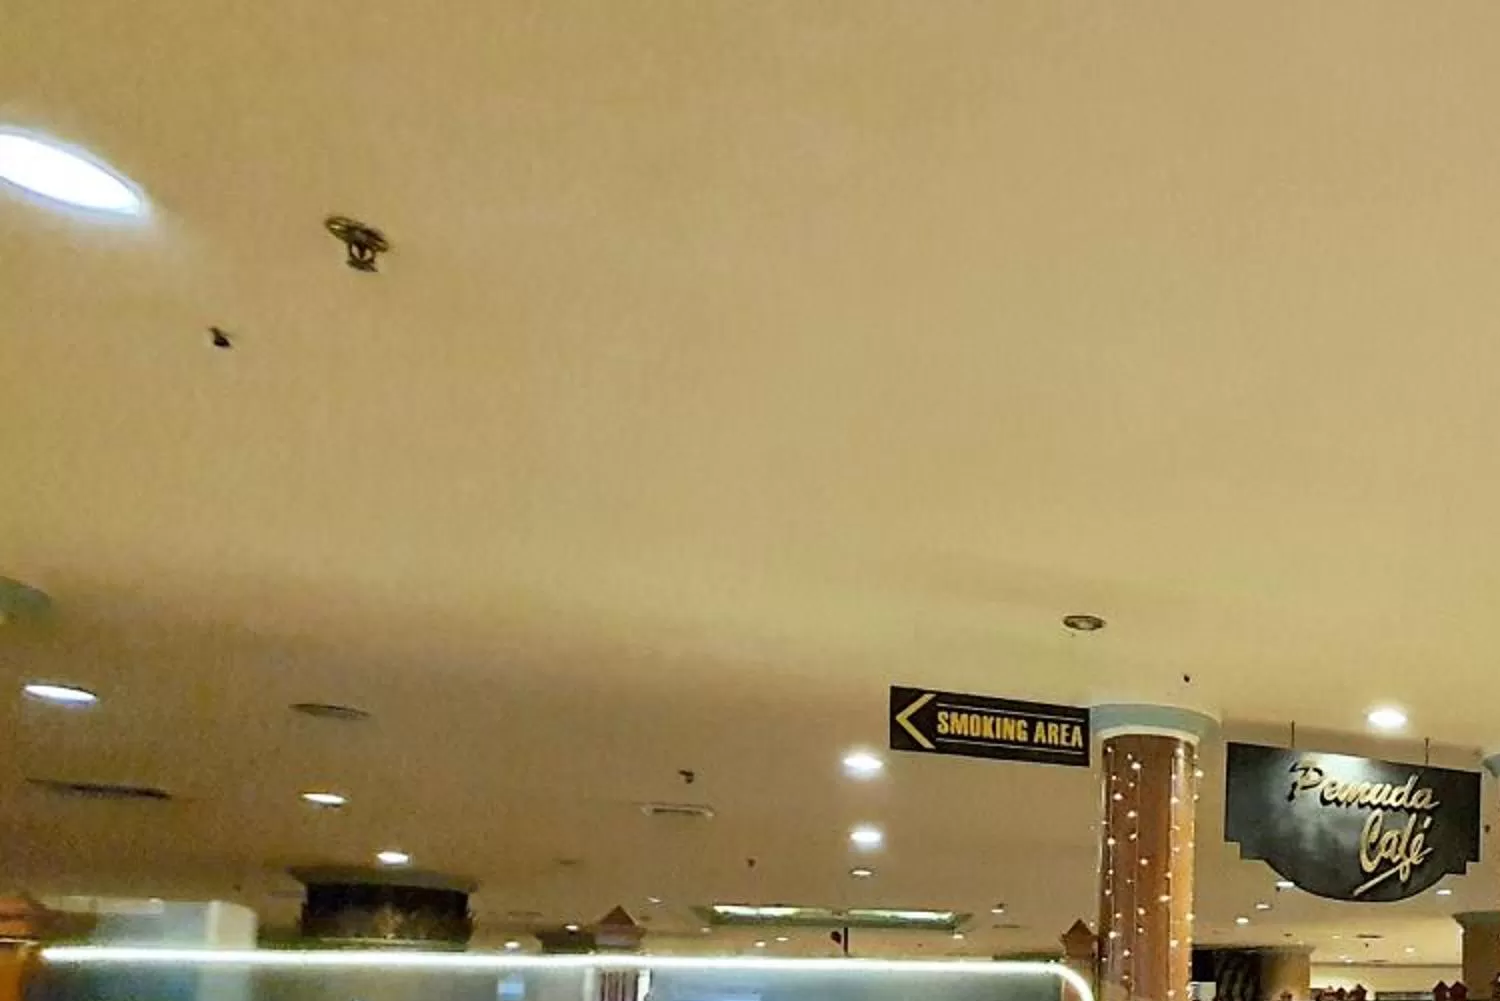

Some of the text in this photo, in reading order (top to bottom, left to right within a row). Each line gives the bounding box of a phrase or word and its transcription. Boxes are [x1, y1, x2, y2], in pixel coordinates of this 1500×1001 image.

[937, 710, 1084, 749] SMOKING AREA
[1287, 759, 1440, 809] Pemuda
[1359, 807, 1434, 884] Café
